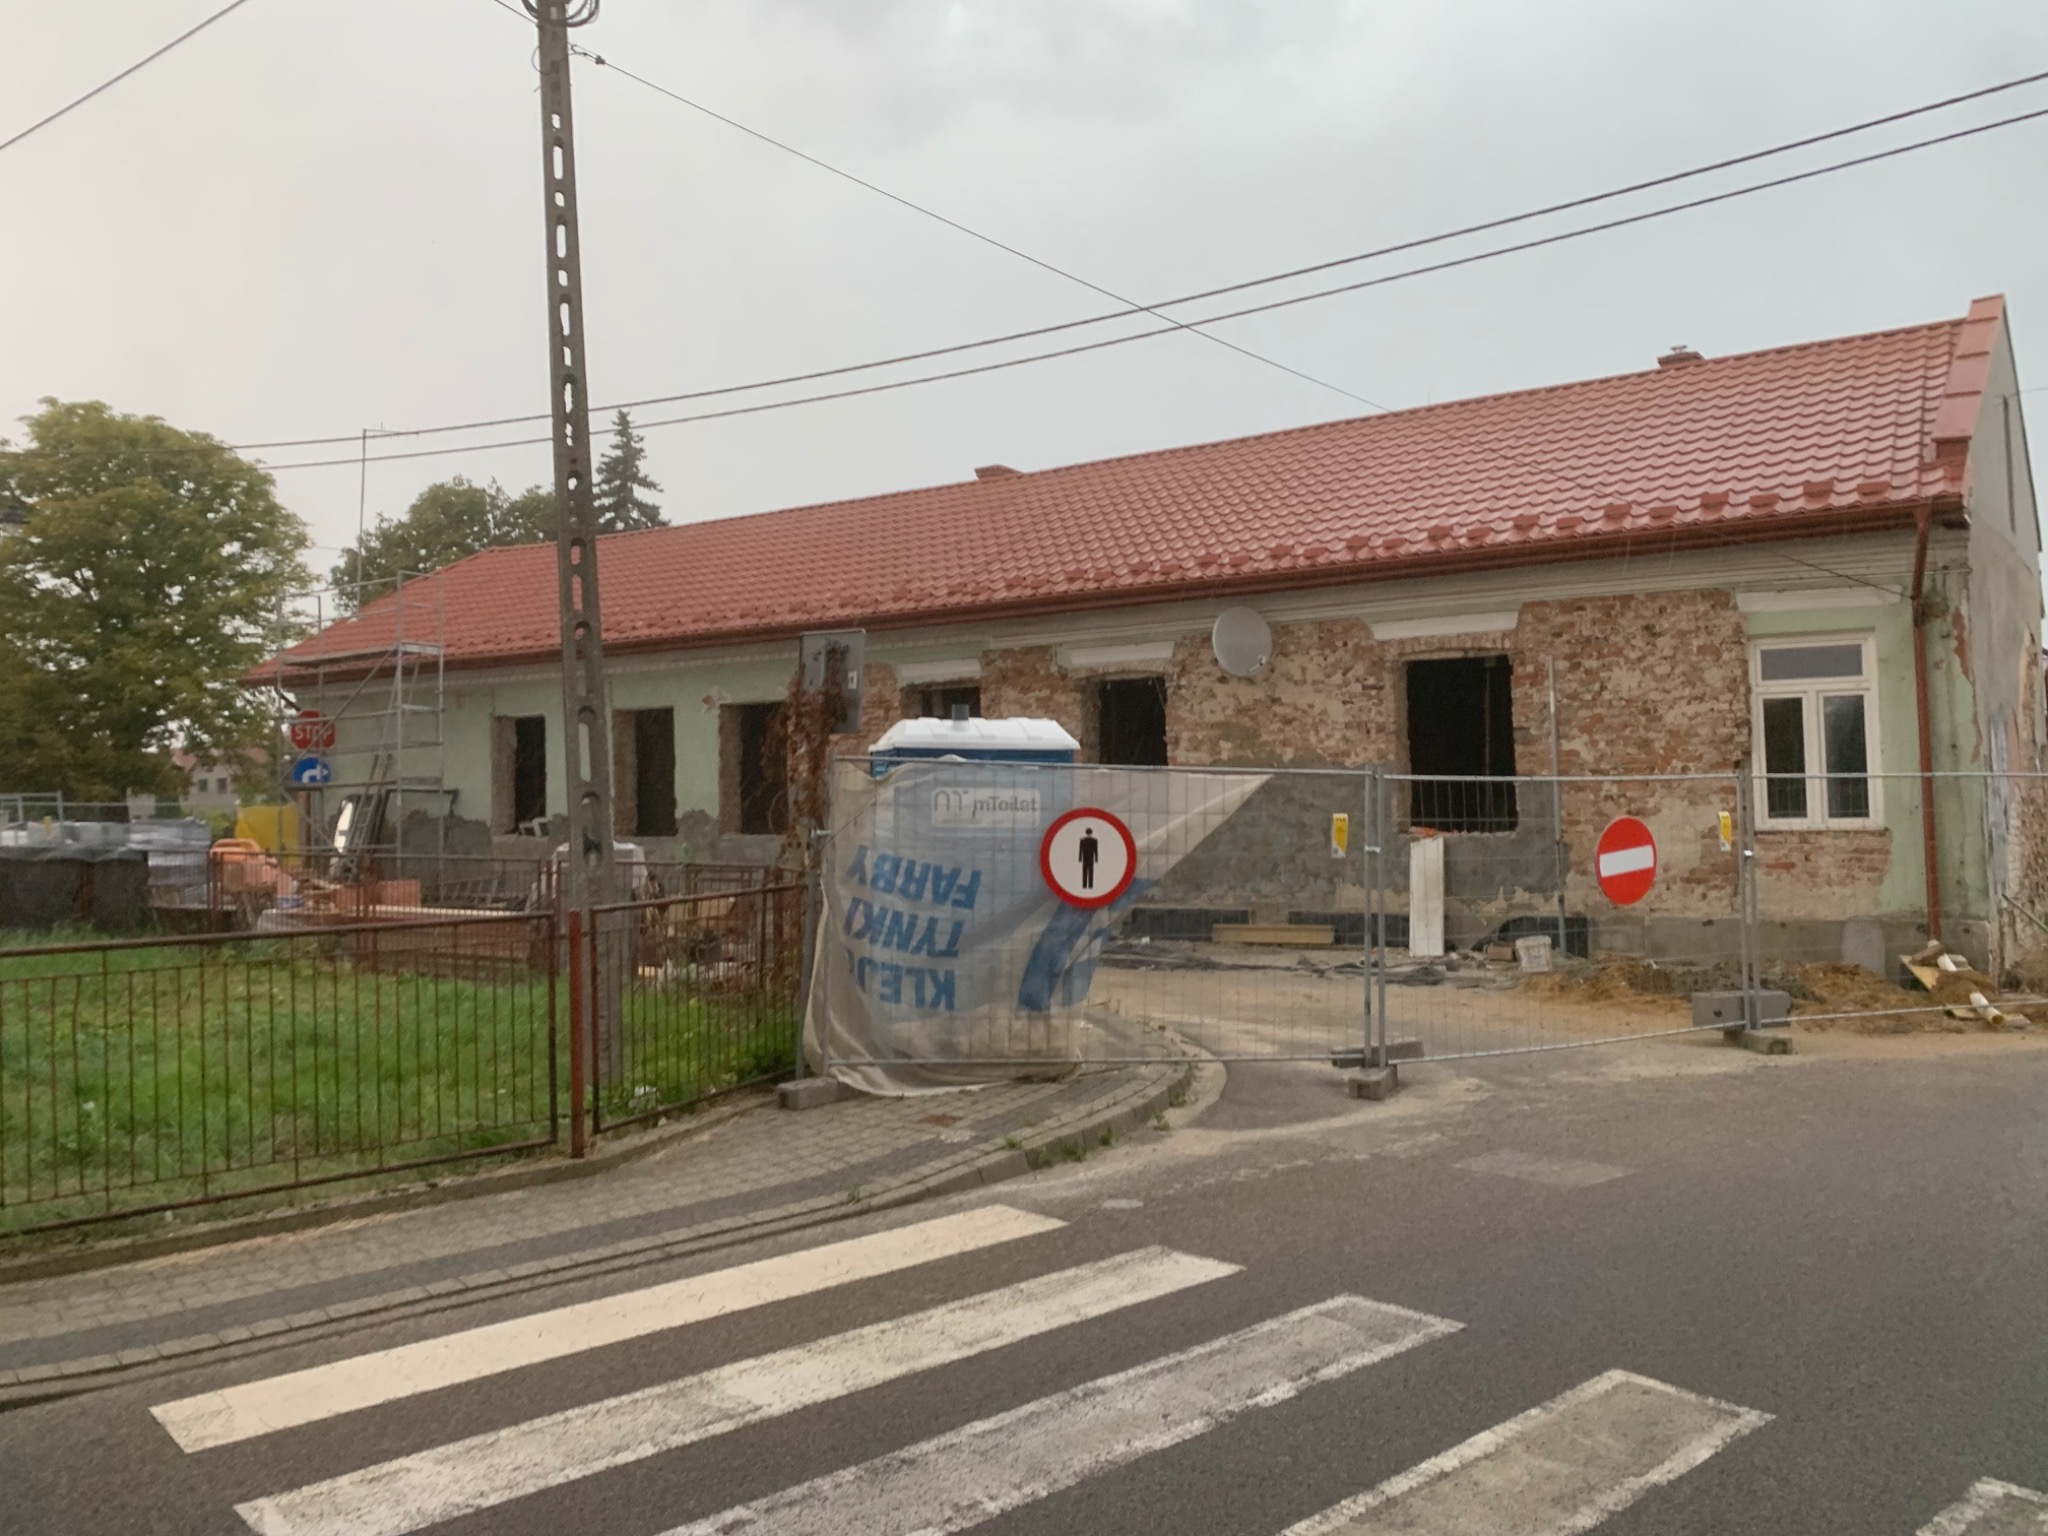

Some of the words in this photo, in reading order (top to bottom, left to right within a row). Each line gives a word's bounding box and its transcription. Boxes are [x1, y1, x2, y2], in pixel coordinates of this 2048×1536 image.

[972, 796, 1038, 818] mToilet
[846, 845, 982, 909] FARBY
[843, 896, 964, 958] TYNKI
